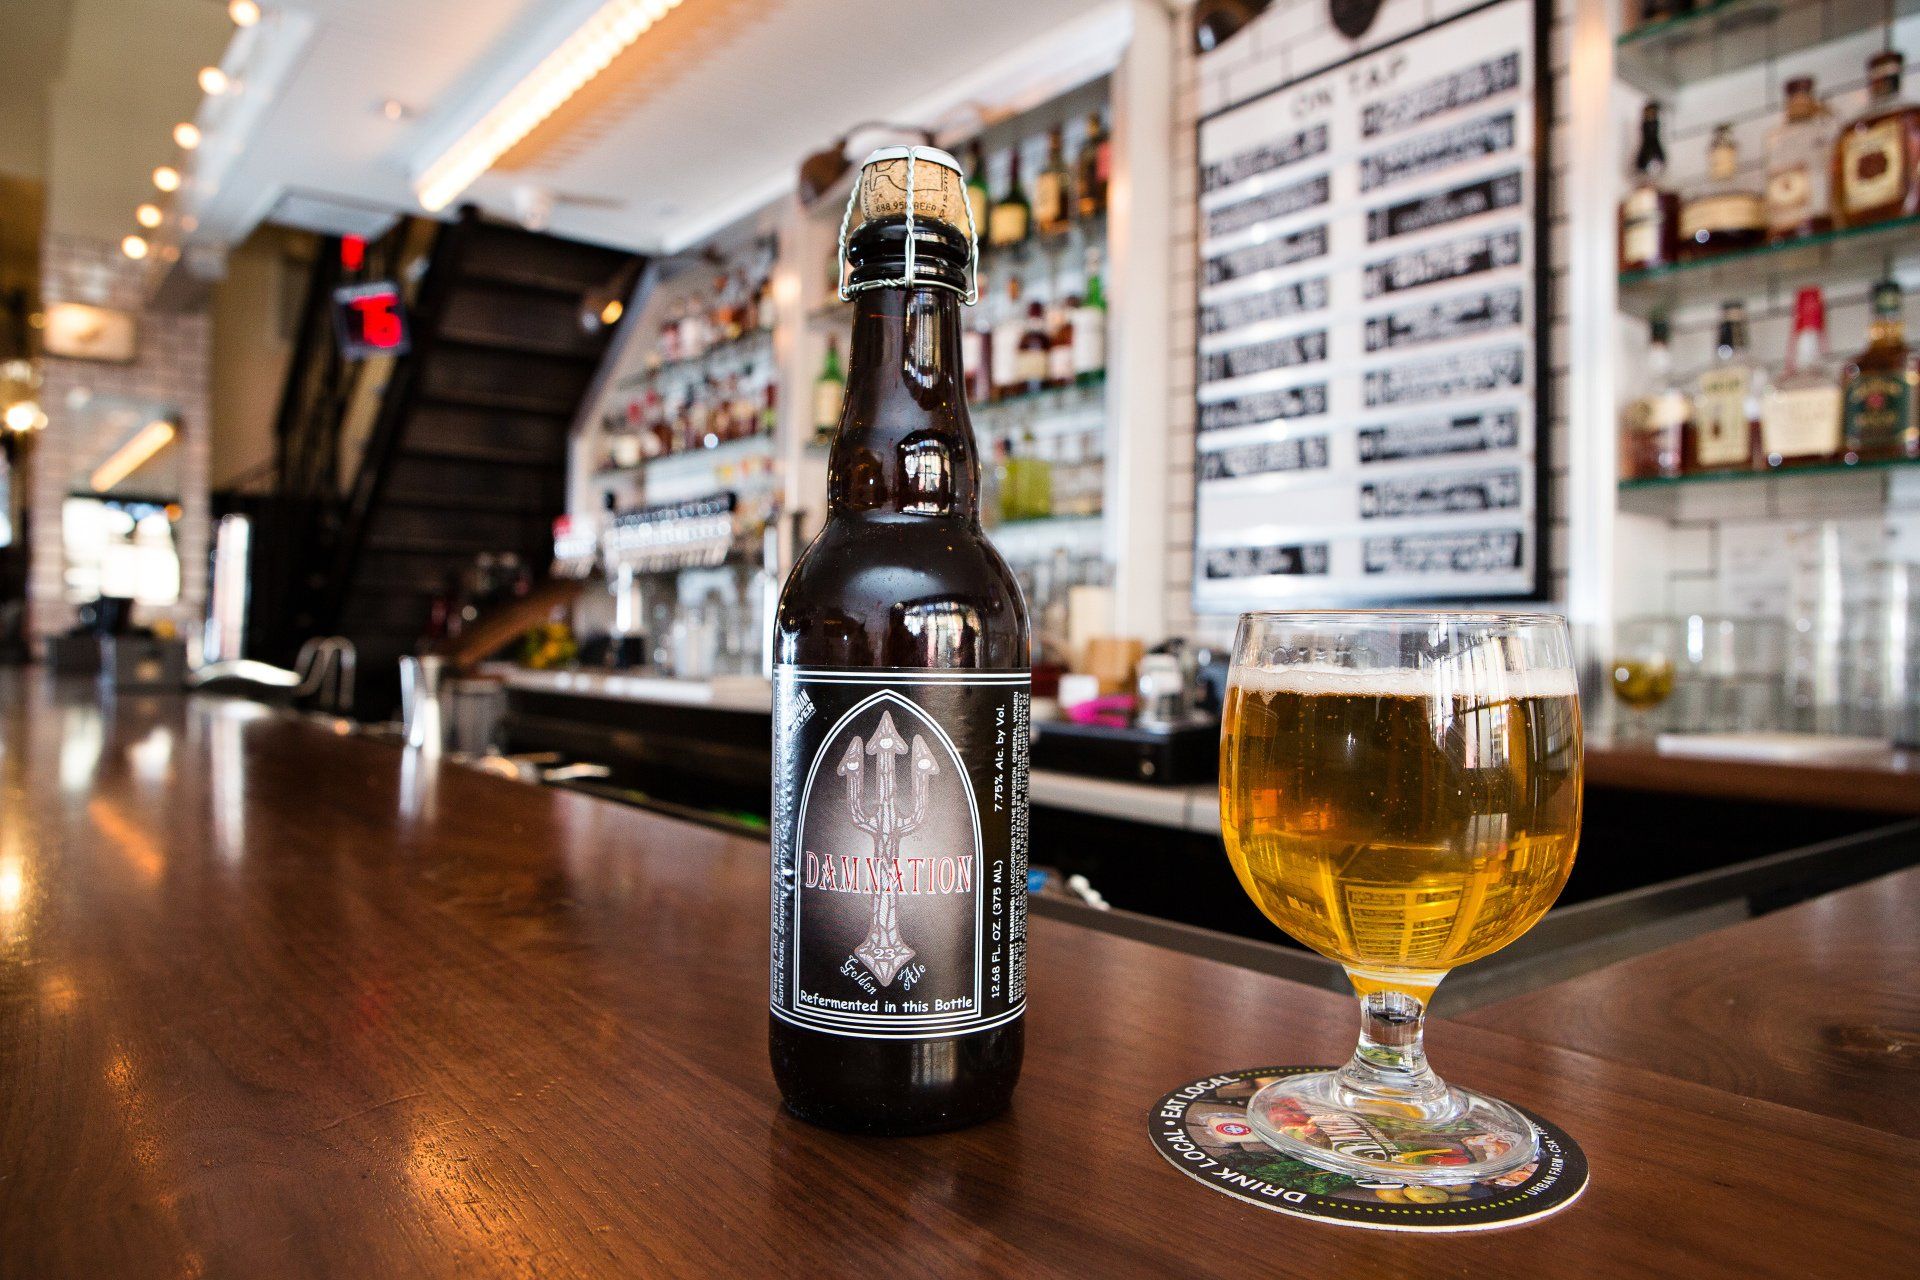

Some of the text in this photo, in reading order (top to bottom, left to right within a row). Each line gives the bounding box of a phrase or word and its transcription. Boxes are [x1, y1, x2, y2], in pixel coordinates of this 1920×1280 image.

[914, 202, 937, 212] BEER
[993, 704, 1006, 813] 7.75% Alc. by Vol.
[1011, 824, 1017, 836] TO
[806, 851, 974, 896] DAMNATION
[778, 890, 786, 935] Sonoma
[990, 859, 1004, 999] 12.68 FL. OZ. (375 ML)
[778, 939, 786, 970] Rosa,
[874, 949, 895, 960] 23
[840, 954, 927, 995] Golden Ale
[800, 989, 973, 1013] Refermented in this Bottle
[1184, 1075, 1241, 1100] LOCAL
[1160, 1098, 1188, 1119] EAT
[1163, 1128, 1219, 1169] LOCAL
[1211, 1166, 1307, 1204] DRINK
[1525, 1140, 1564, 1196] URBAN FARM CSA
